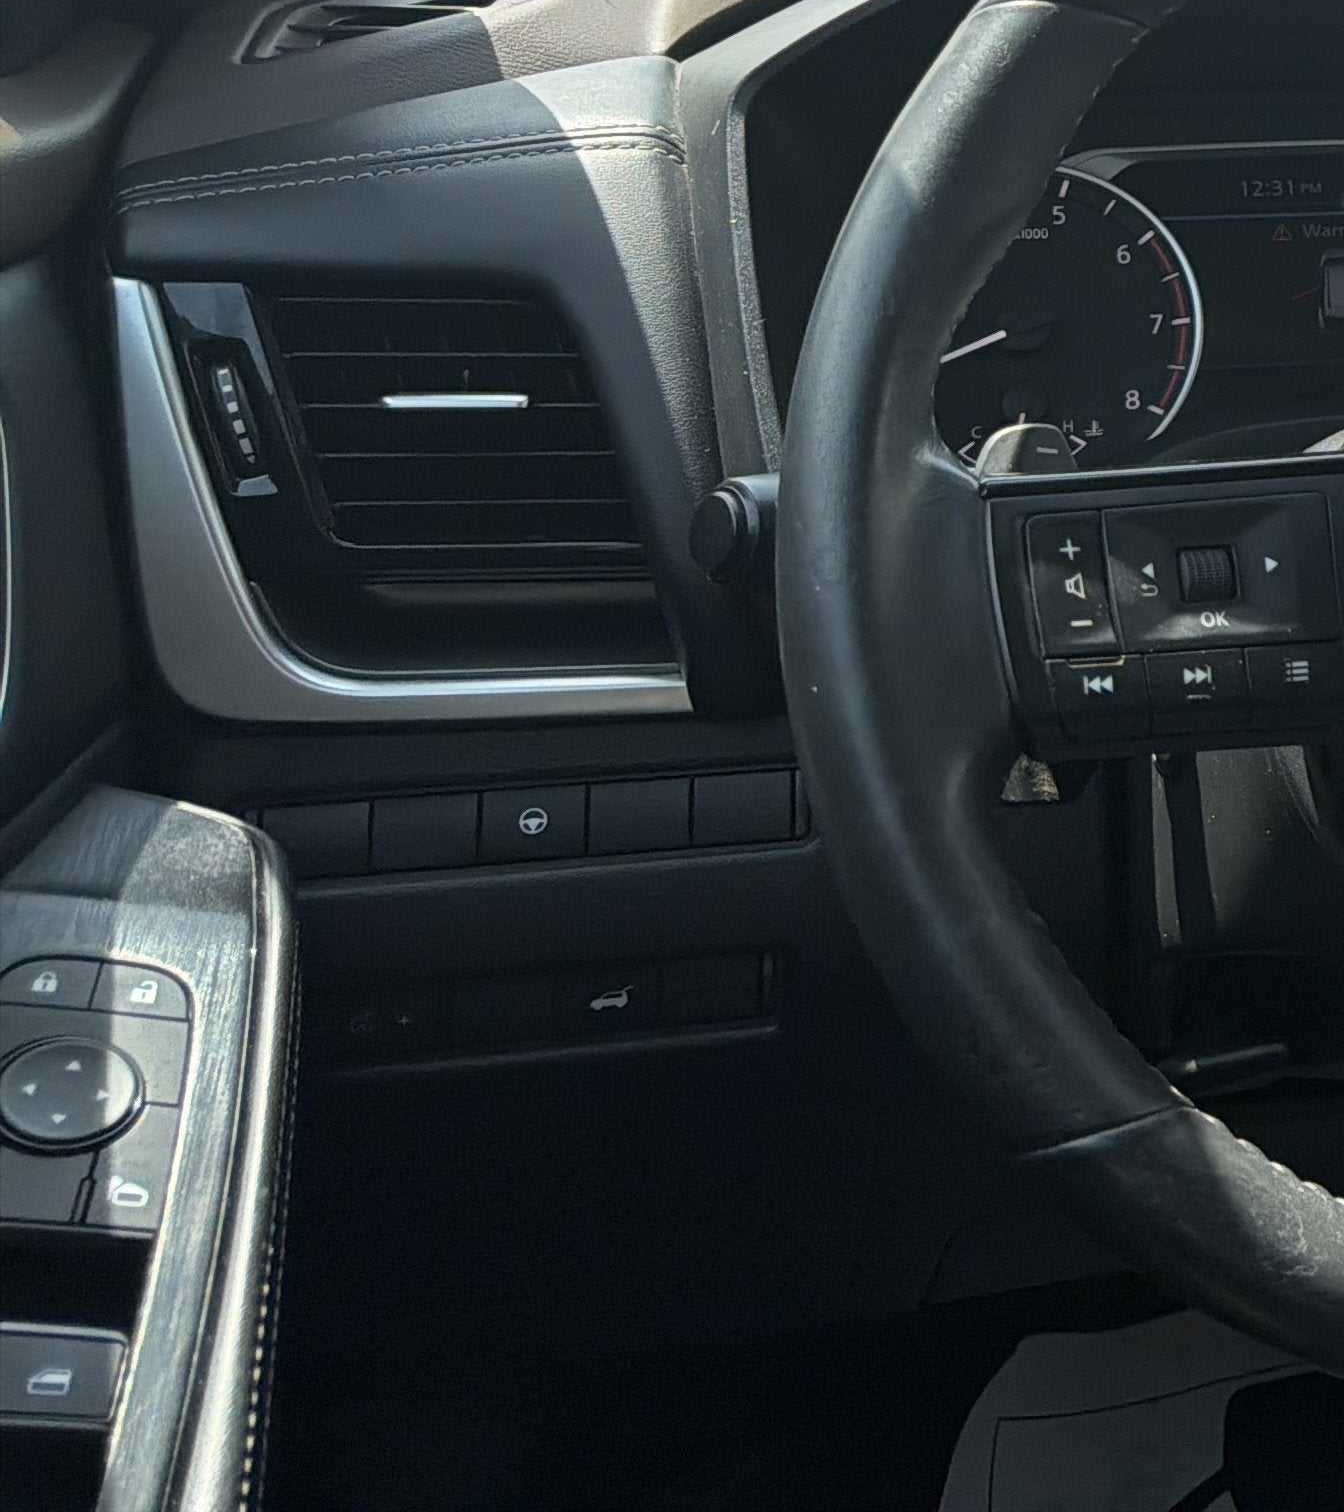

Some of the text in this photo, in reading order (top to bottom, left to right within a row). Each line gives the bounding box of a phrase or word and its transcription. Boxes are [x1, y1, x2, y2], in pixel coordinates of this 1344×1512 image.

[1241, 180, 1322, 198] 12:31 PM
[1051, 205, 1067, 226] 5
[1116, 244, 1132, 265] 6
[1150, 313, 1164, 335] 7
[1125, 390, 1141, 410] 8
[970, 425, 983, 439] C
[1063, 419, 1074, 432] H
[1200, 611, 1230, 628] OK
